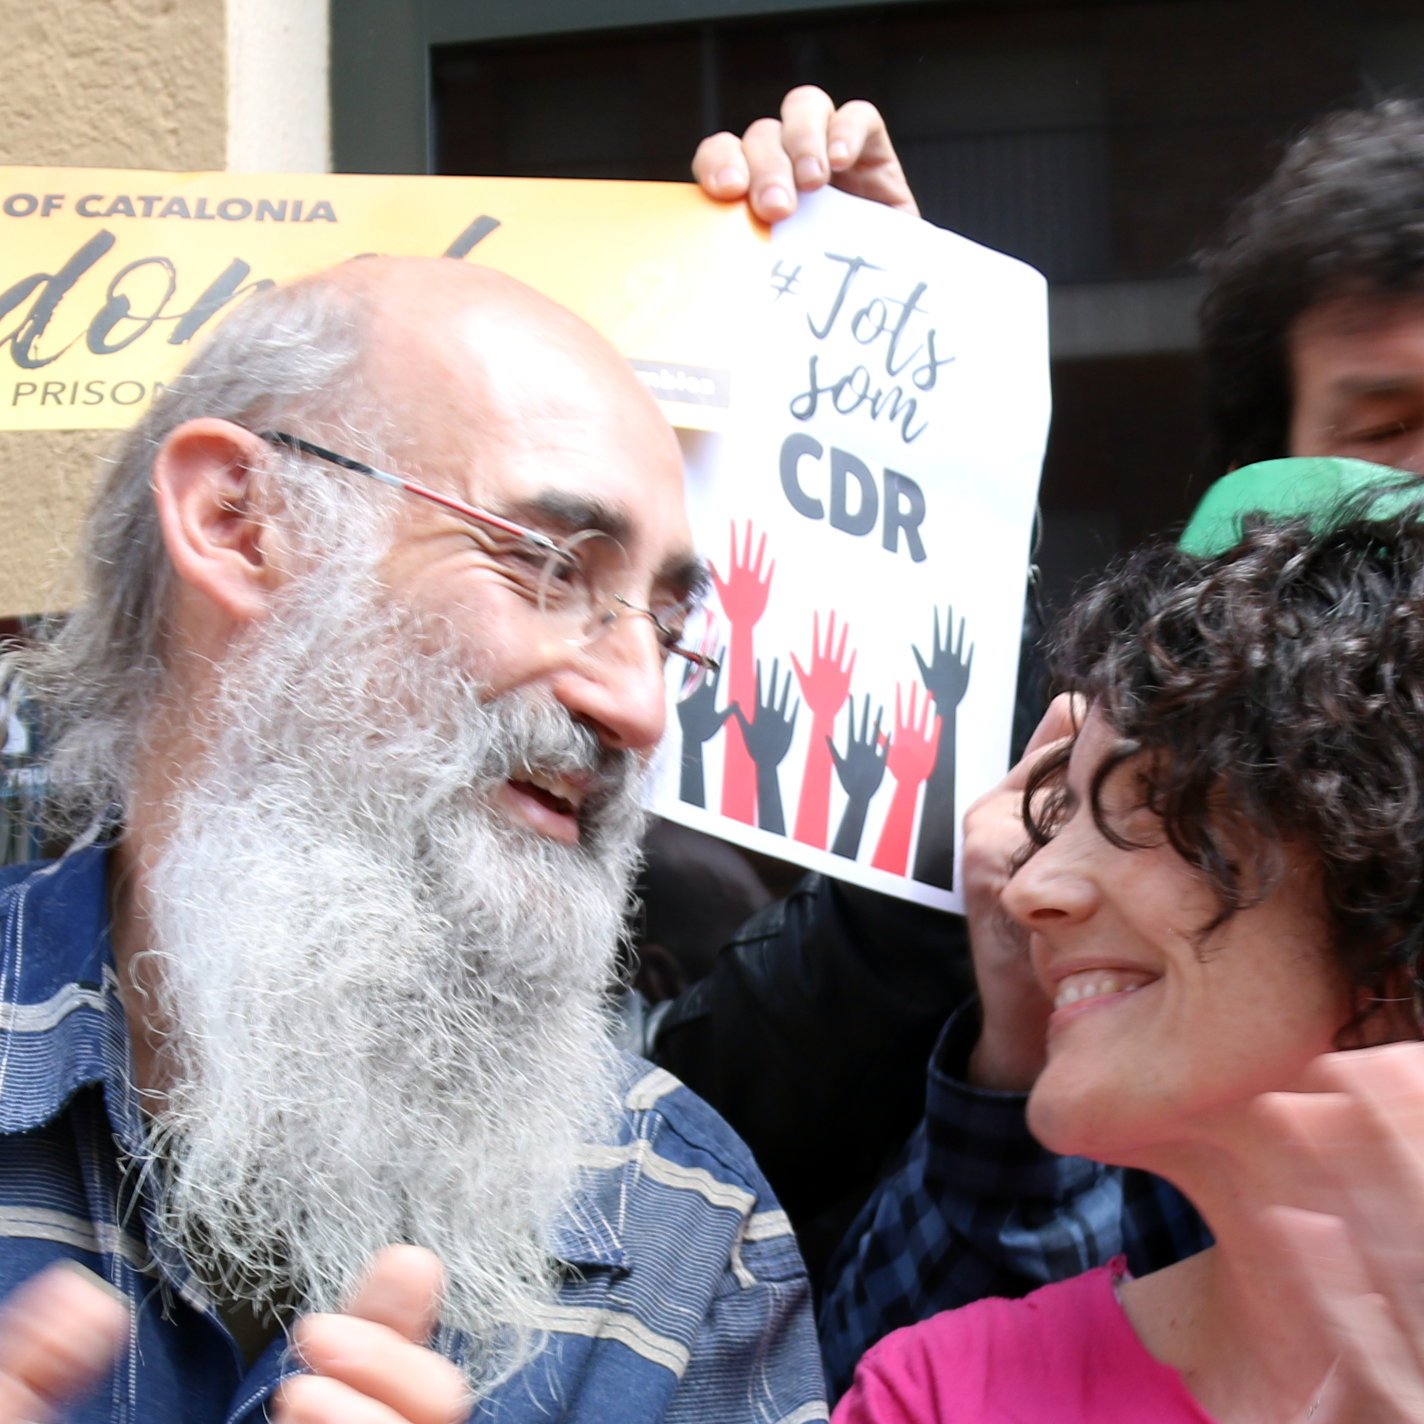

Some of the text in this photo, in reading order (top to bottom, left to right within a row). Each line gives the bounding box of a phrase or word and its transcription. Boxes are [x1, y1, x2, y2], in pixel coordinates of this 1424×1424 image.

[2, 193, 66, 217] OF
[75, 192, 339, 223] CATALONIA
[789, 354, 929, 443] som
[779, 432, 928, 563] CDR
